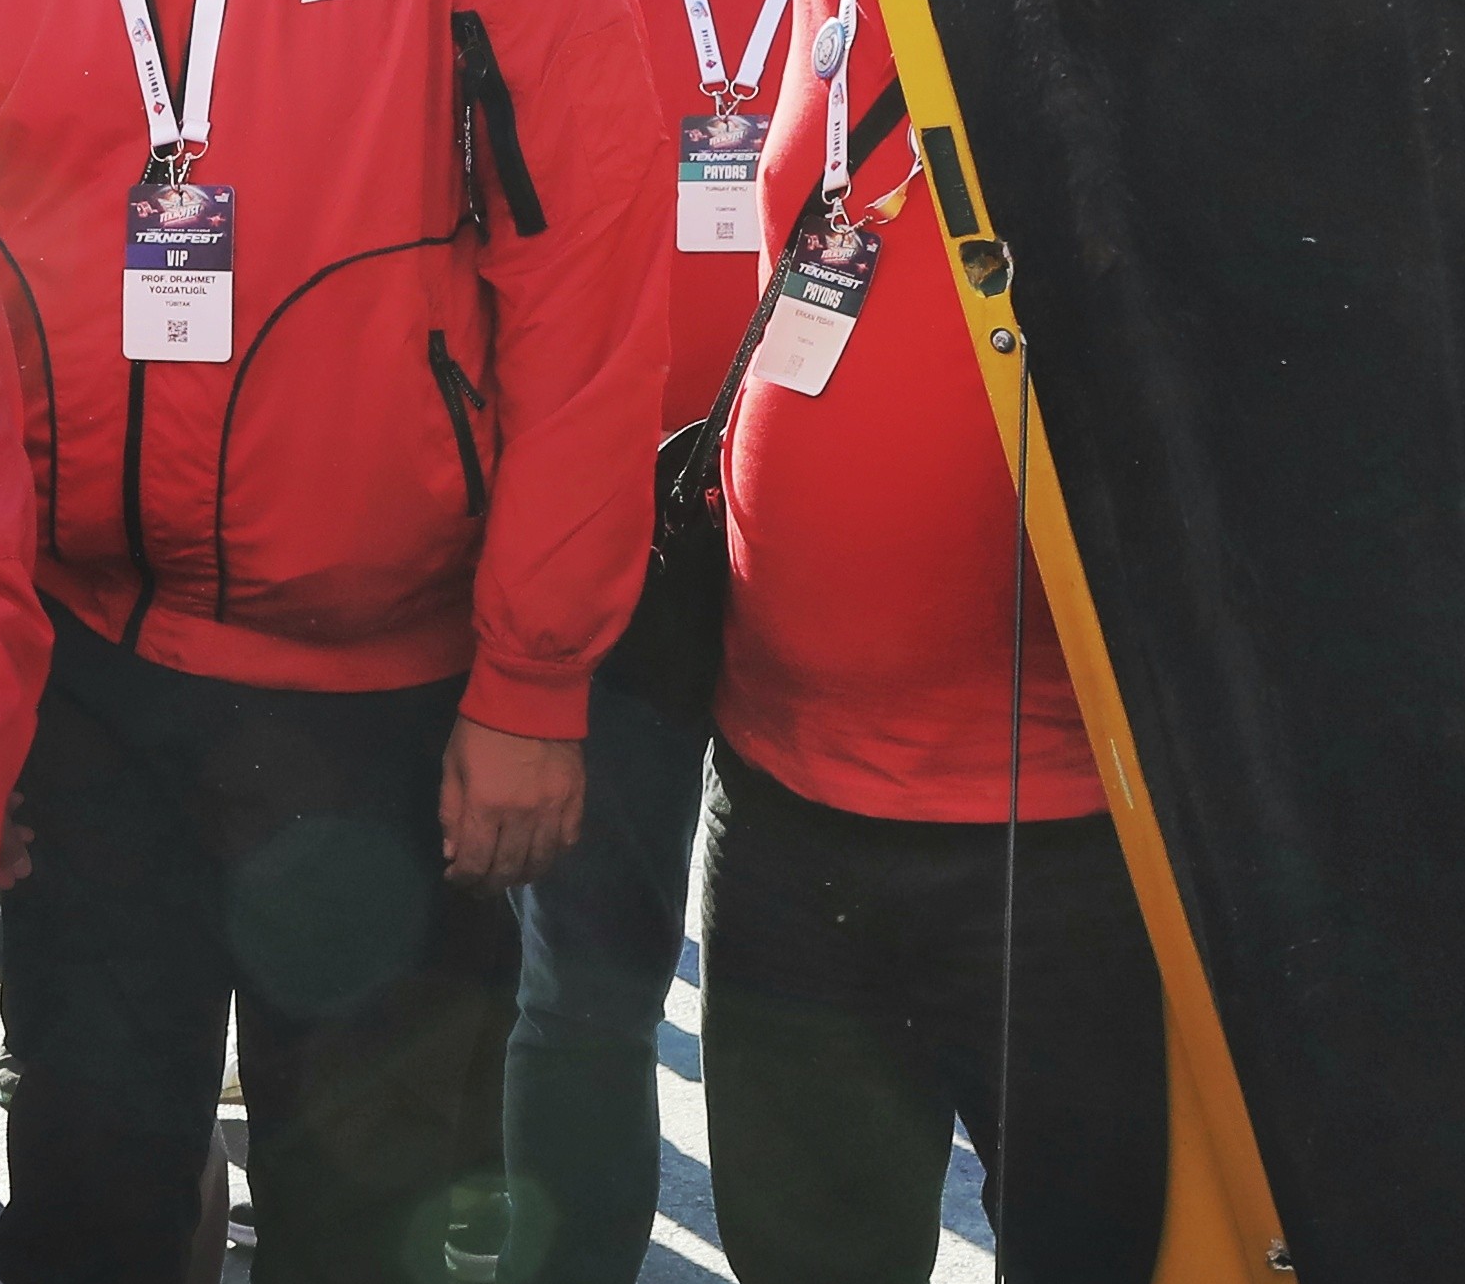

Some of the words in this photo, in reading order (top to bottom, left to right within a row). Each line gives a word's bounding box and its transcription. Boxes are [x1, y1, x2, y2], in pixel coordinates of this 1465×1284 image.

[689, 152, 762, 162] TEKNOFEST
[136, 231, 224, 245] TEKNOFEST
[166, 250, 189, 267] VIP
[798, 262, 864, 290] TEKNOFEST
